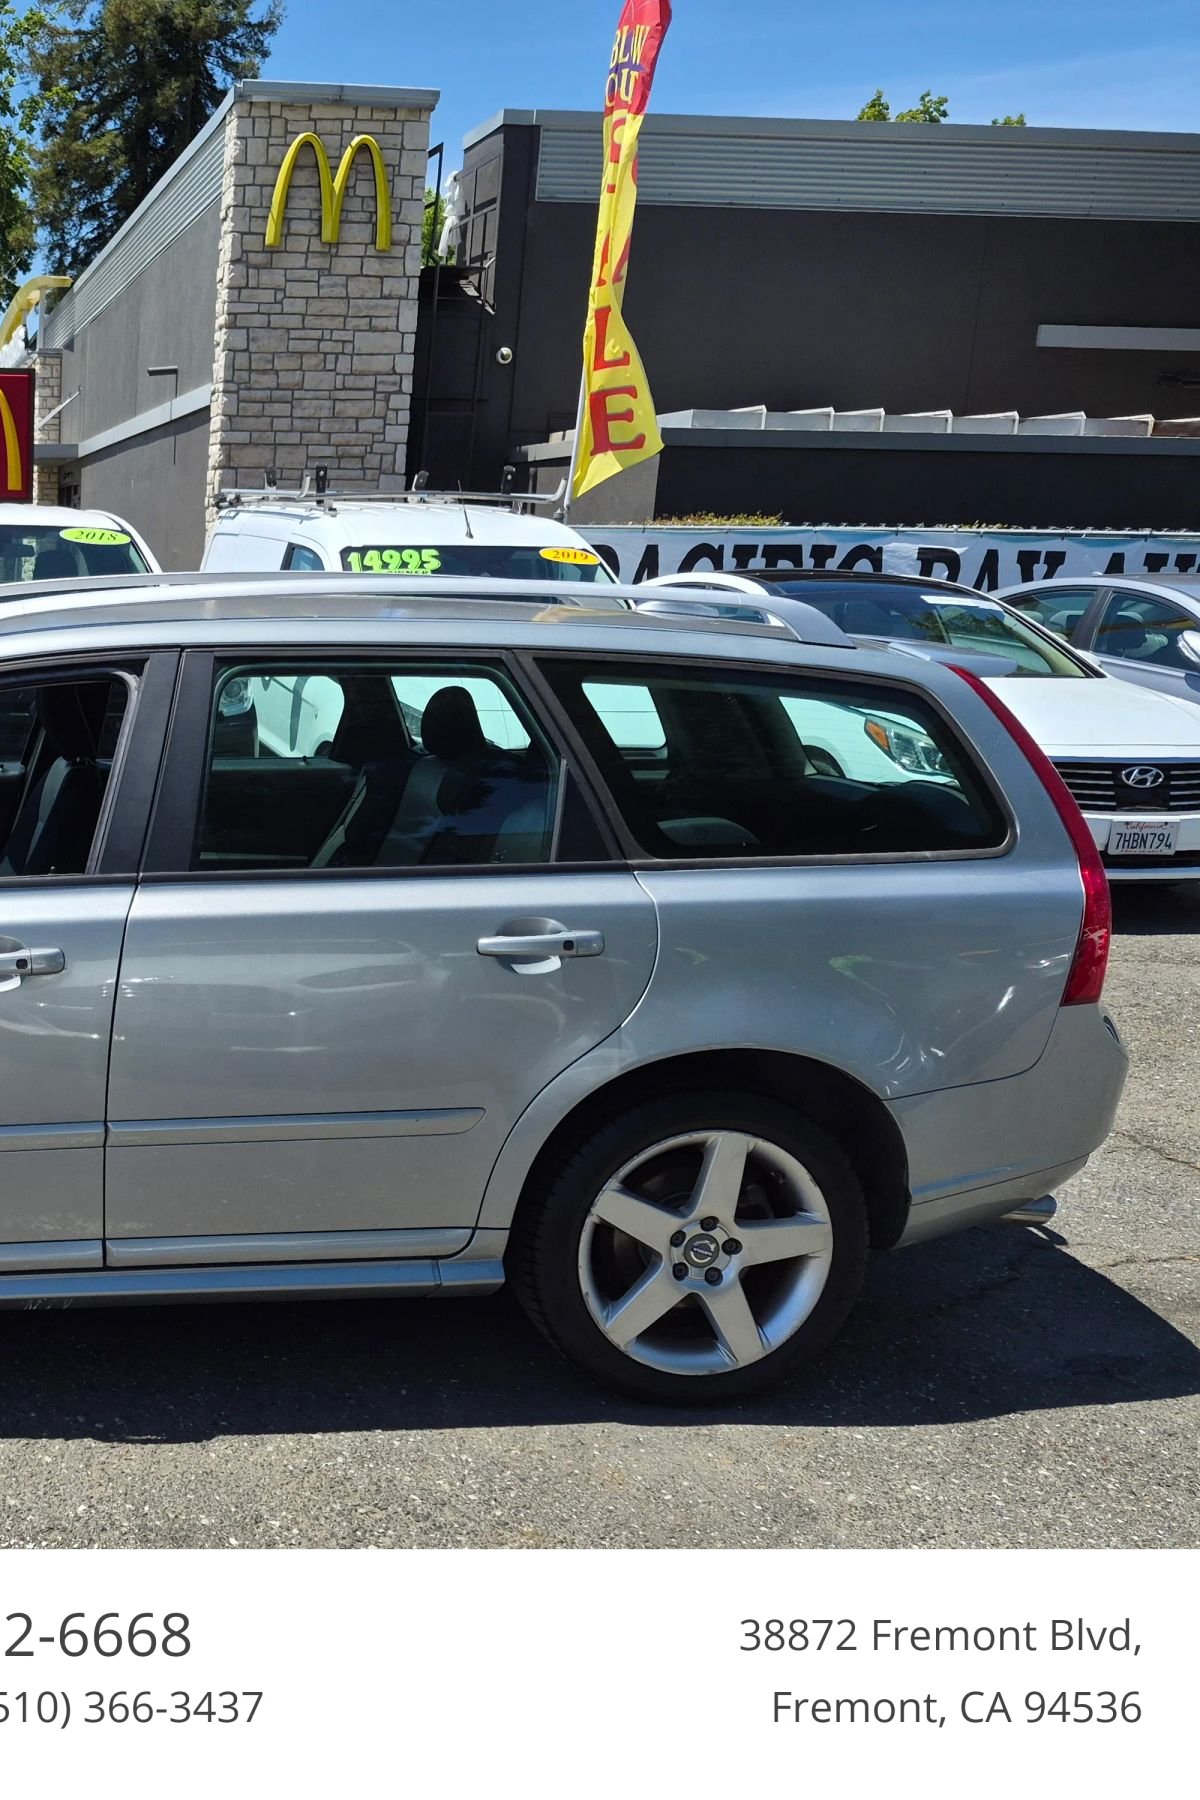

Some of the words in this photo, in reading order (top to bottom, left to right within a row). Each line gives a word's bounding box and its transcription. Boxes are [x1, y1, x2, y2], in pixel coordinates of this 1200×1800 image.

[74, 531, 118, 541] 2018
[347, 549, 441, 574] 14995
[551, 550, 589, 560] 2019
[1115, 832, 1172, 850] 7HBN794
